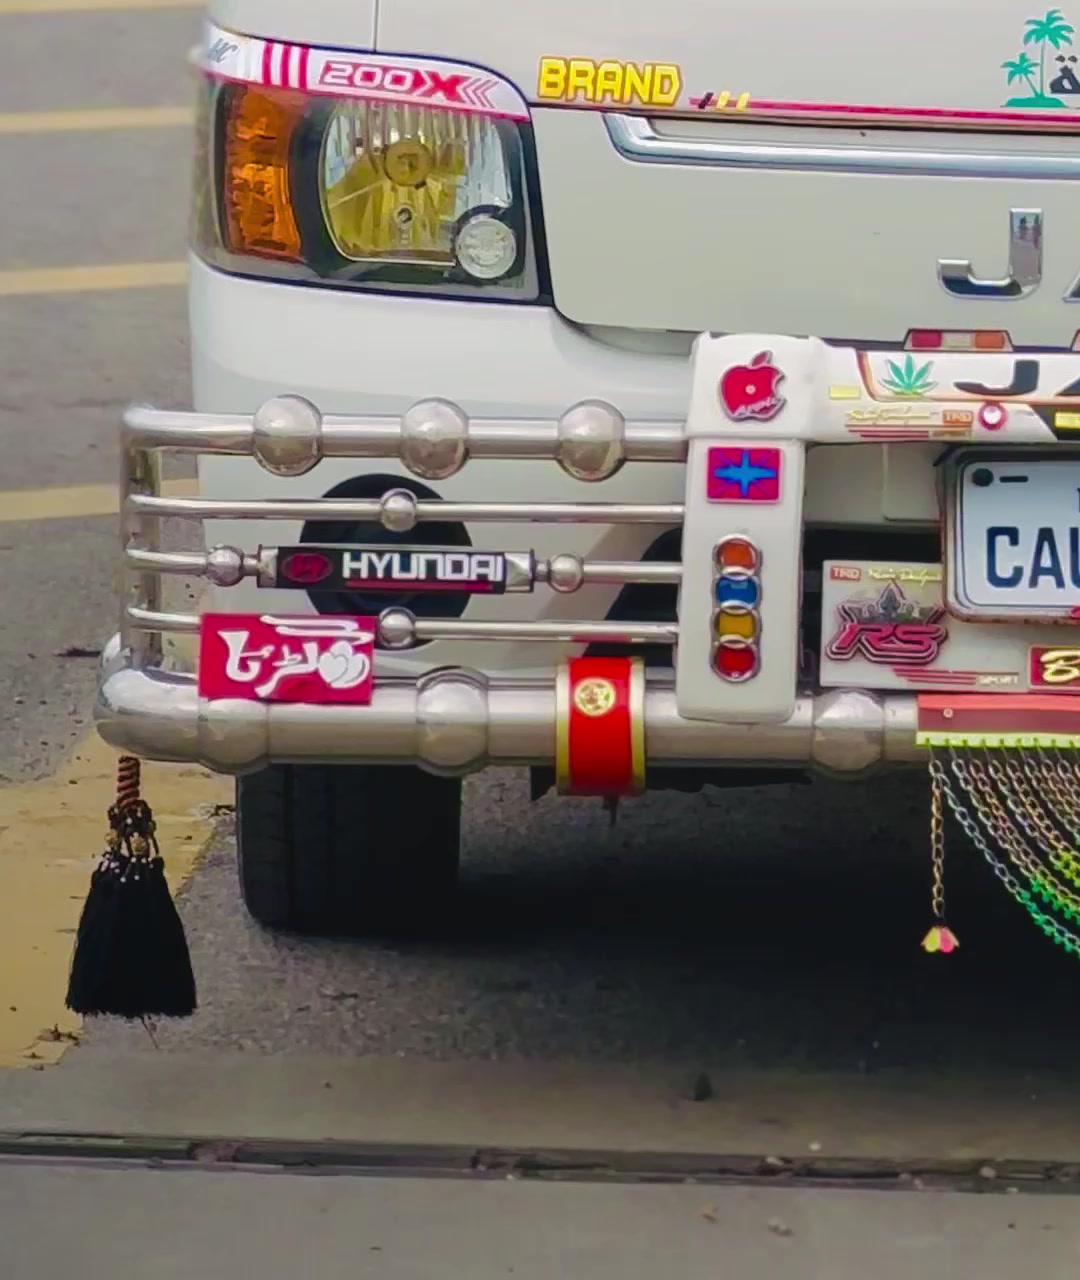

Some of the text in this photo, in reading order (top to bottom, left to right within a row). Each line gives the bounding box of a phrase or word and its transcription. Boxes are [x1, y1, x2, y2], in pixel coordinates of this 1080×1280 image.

[537, 56, 685, 108] BRAND
[341, 551, 505, 582] HYUNDAI
[827, 622, 948, 664] RS
